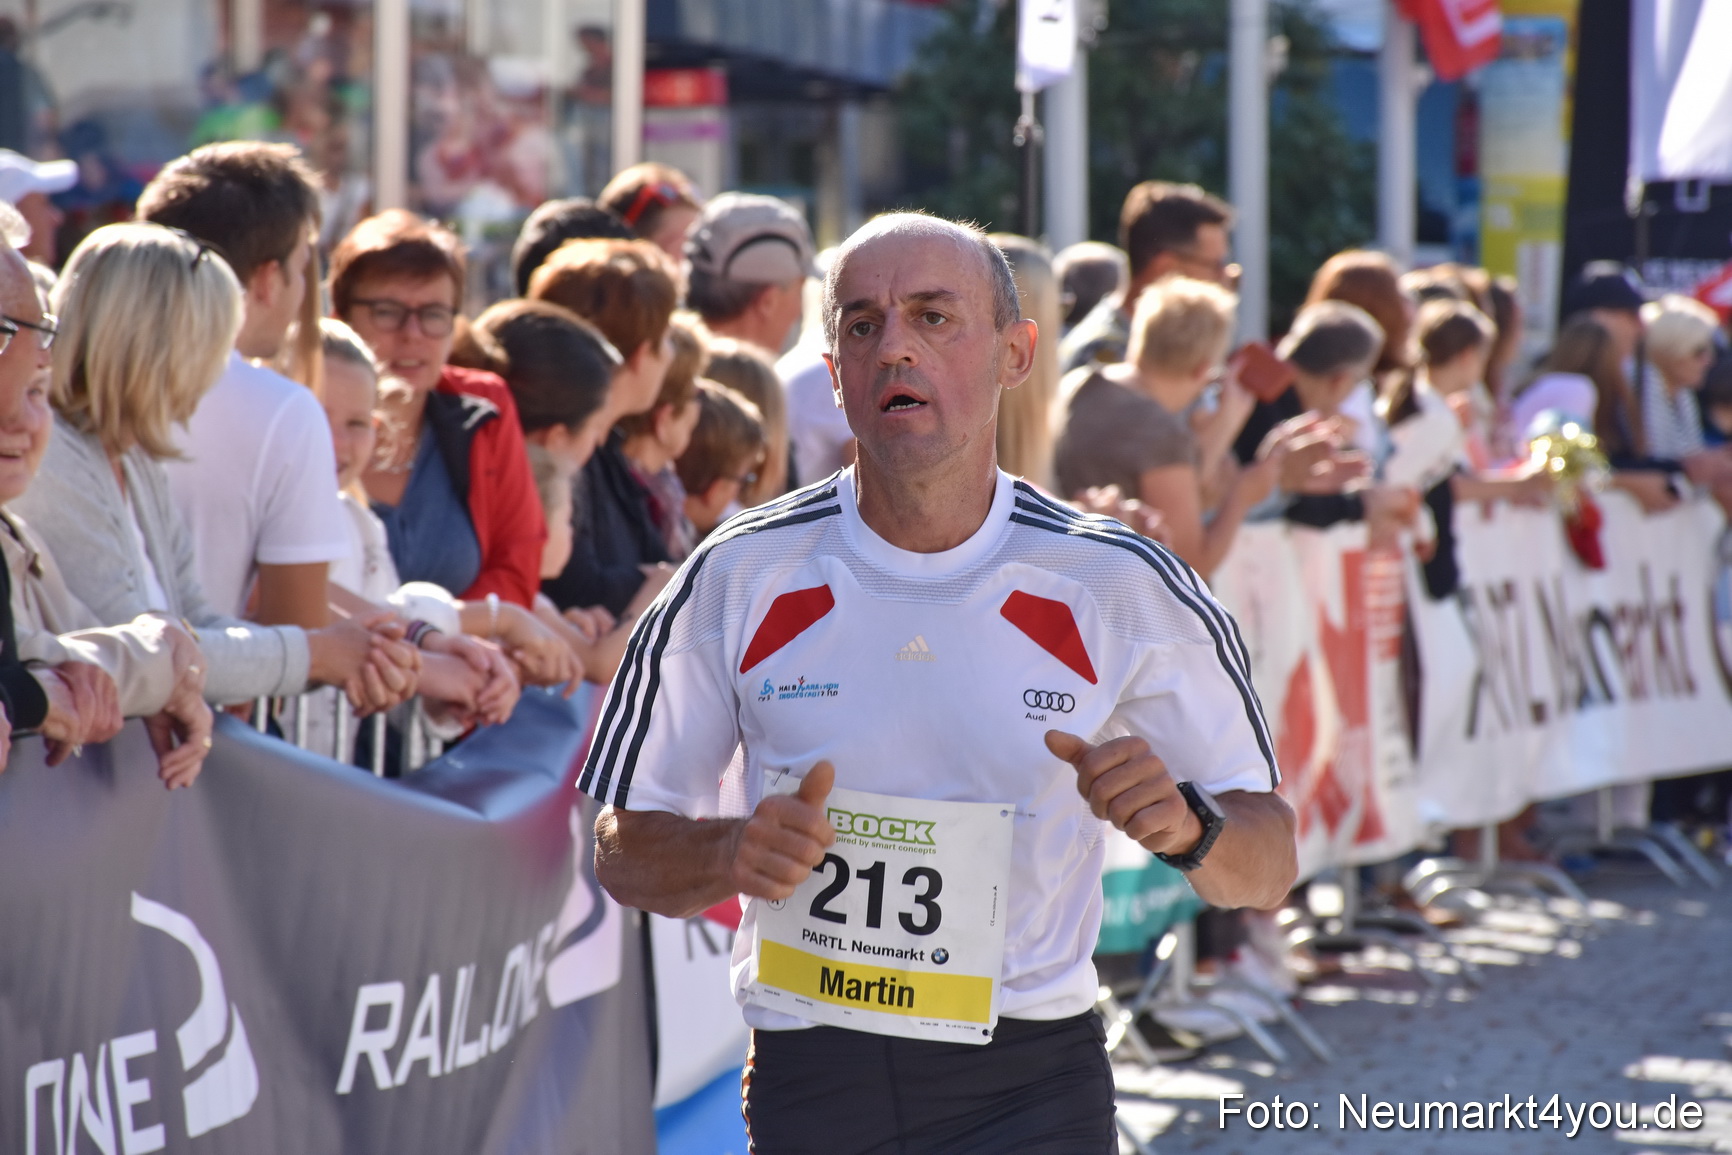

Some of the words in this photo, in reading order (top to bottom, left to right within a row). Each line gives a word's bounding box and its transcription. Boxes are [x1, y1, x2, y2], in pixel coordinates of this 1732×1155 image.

[1025, 712, 1047, 722] Audi
[827, 808, 937, 846] BOCK
[859, 838, 870, 848] by
[872, 840, 896, 851] smart
[898, 844, 937, 855] concepts
[808, 852, 944, 936] 213
[801, 928, 848, 952] PARTL
[851, 940, 926, 962] Neumarkt
[819, 966, 916, 1009] Martin
